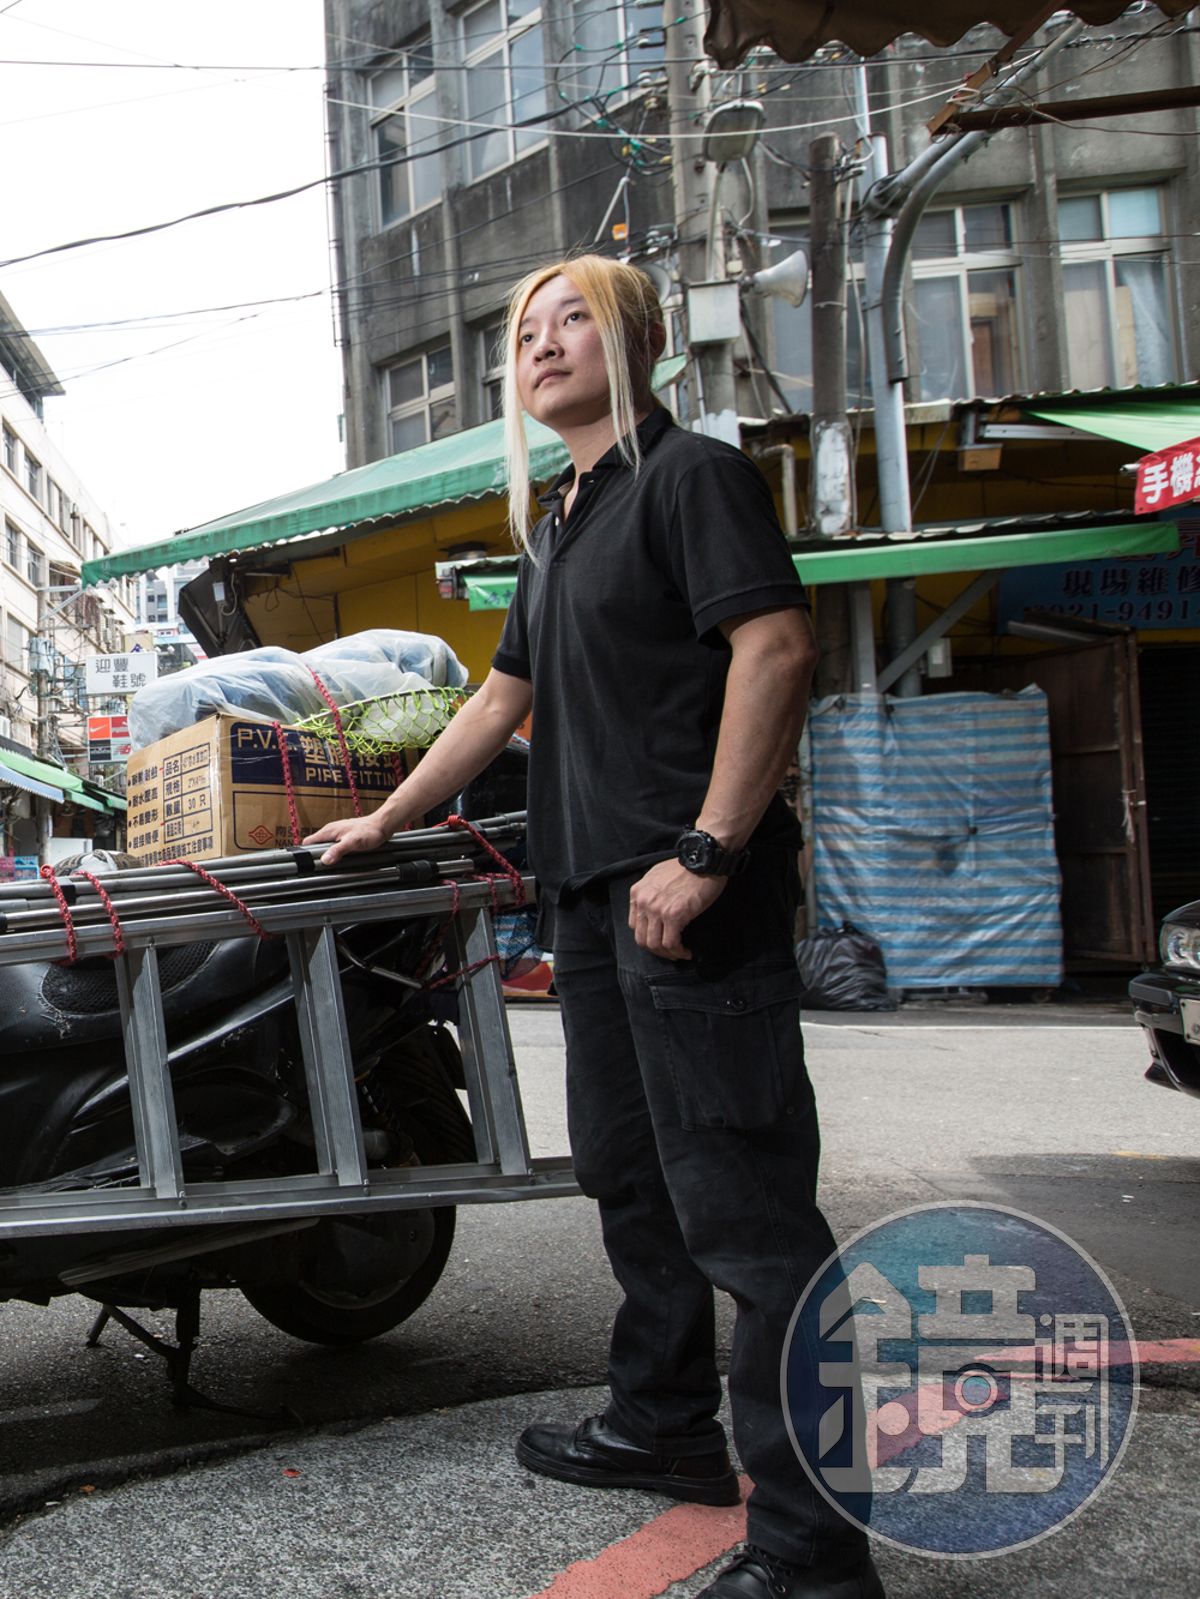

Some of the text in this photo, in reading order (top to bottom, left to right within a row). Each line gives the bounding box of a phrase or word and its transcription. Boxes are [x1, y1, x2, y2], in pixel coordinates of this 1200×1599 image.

[112, 673, 146, 688] 鞋號
[165, 759, 180, 776] 品名
[306, 766, 397, 787] PIPE FITTIN
[165, 780, 181, 796] 規格
[166, 800, 181, 817] 數量
